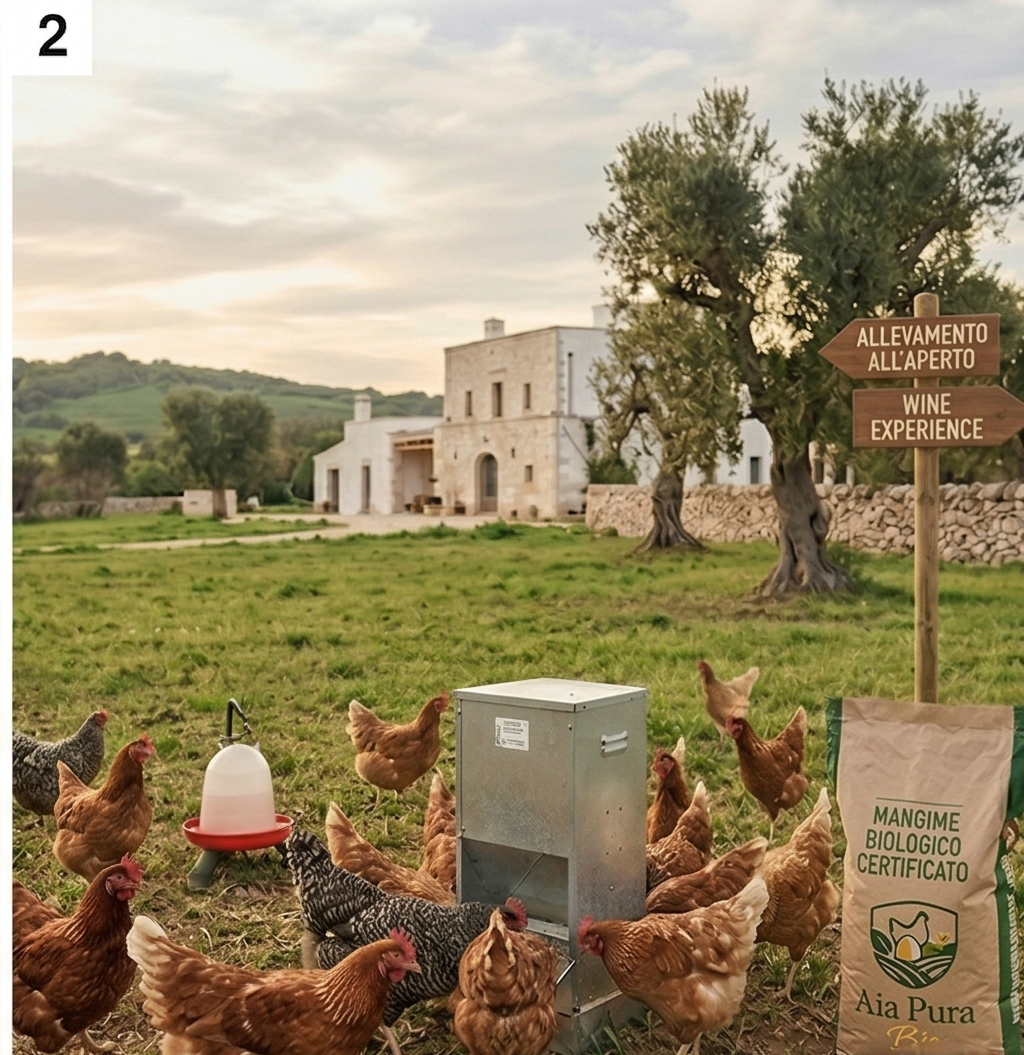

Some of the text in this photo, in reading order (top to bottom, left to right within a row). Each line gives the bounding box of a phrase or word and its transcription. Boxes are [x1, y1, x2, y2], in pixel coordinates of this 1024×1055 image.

[856, 322, 988, 348] ALLEVAMENTO
[867, 348, 975, 372] ALL'APERTO
[902, 393, 951, 415] WINE
[871, 418, 983, 440] EXPERIENCE
[873, 805, 961, 832] MANGIME
[865, 828, 962, 857] BIOLOGICO
[857, 852, 969, 883] CERTIFICATO
[855, 988, 976, 1025] Aia Pura
